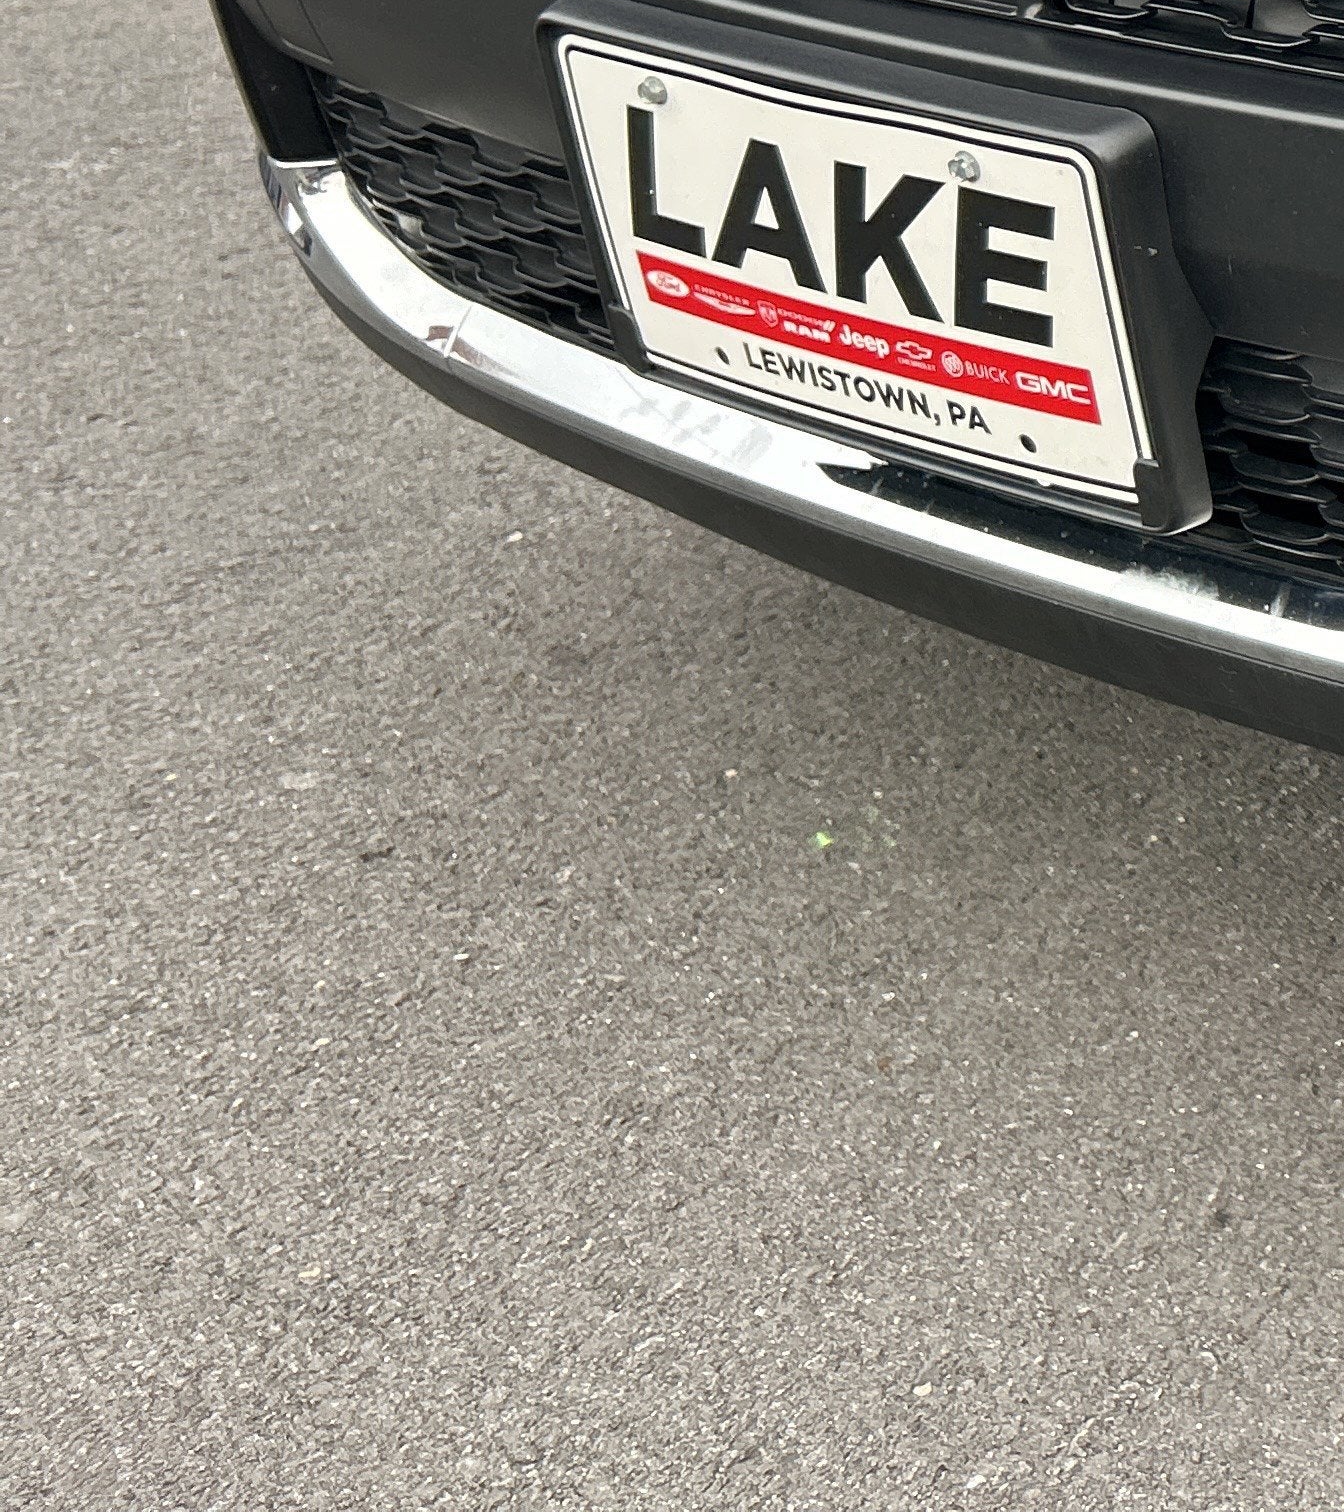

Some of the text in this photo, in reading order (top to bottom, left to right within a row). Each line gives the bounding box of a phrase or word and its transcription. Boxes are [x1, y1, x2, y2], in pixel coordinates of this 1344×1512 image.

[627, 106, 1056, 348] LAKE
[839, 323, 890, 359] Jeep
[742, 341, 993, 436] LEWISTOWN, PA
[964, 361, 1011, 386] BUICK
[1015, 370, 1092, 405] GMC
